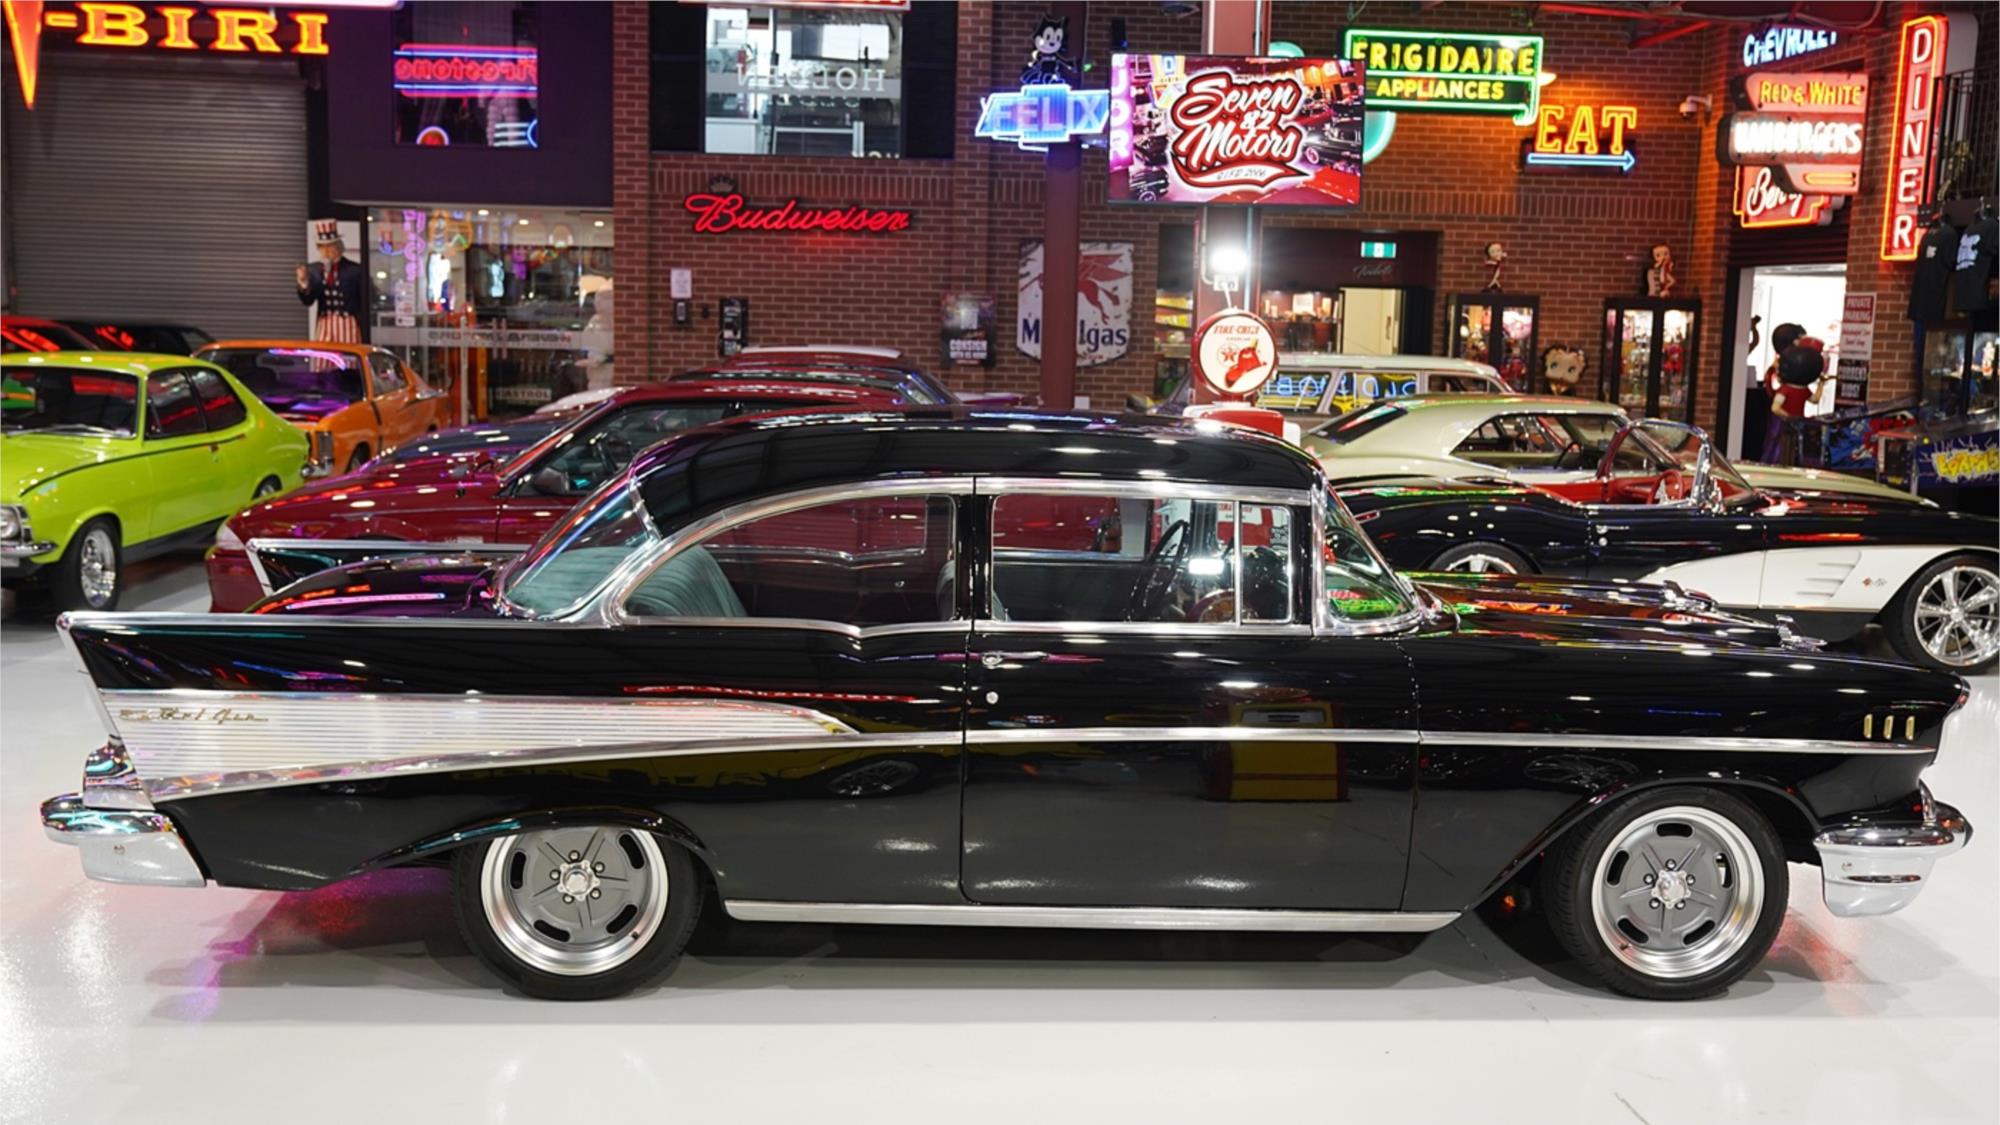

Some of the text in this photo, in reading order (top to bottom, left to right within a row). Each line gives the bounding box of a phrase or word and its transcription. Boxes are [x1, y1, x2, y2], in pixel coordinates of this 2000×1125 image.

[1352, 40, 1536, 75] FRIGIDAIRE
[1177, 76, 1297, 126] Seven
[1377, 78, 1505, 100] APPLIANCES
[1760, 80, 1862, 106] RED & WHITE
[994, 97, 1100, 131] FELIX
[1536, 104, 1638, 155] EAT
[1178, 119, 1298, 170] Motors
[1733, 121, 1863, 154] HAMBURGERS
[1893, 28, 1932, 249] DINER
[685, 194, 911, 233] Budweiser
[1021, 318, 1128, 353] Mlgas
